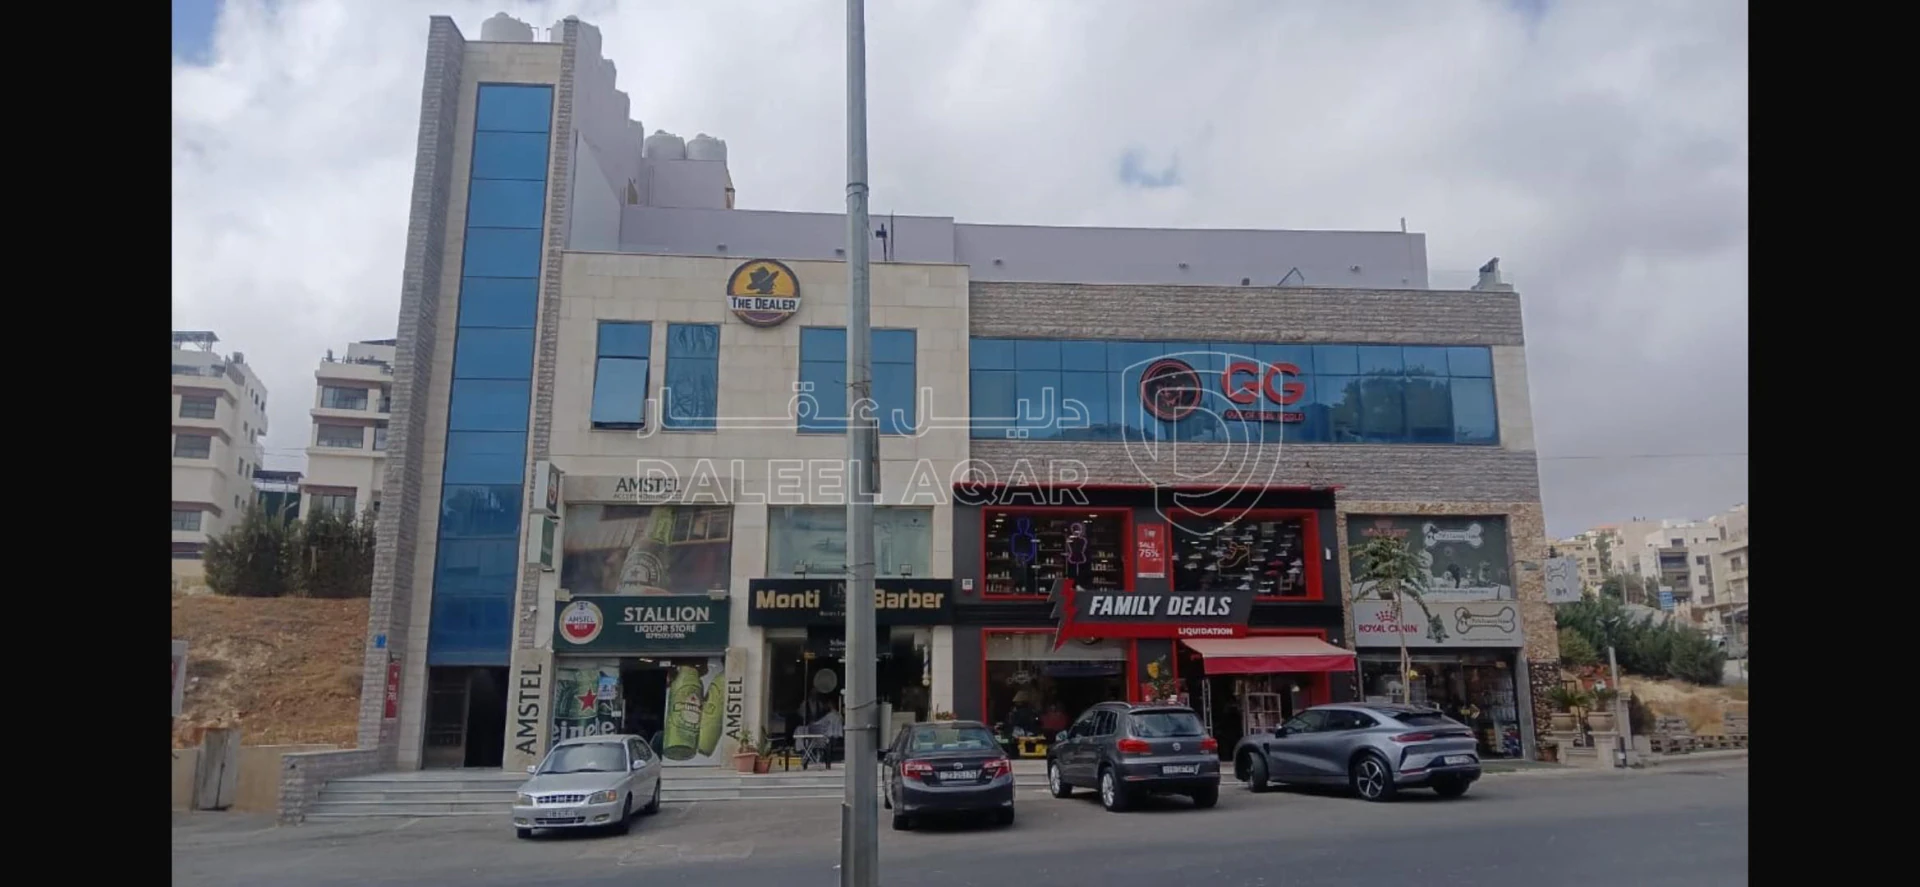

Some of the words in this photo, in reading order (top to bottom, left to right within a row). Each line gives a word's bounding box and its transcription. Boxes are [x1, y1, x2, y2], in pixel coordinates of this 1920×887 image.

[732, 297, 751, 309] THE
[755, 297, 795, 310] DEALER
[1221, 361, 1306, 405] GG
[615, 477, 681, 493] AMSTEL
[756, 588, 820, 609] Monti
[875, 588, 944, 609] Barber
[1089, 596, 1162, 616] FAMILY
[1167, 596, 1232, 616] DEALS
[624, 606, 710, 622] STALLION
[635, 624, 668, 634] LIQUOR
[671, 624, 696, 633] STORE
[1178, 627, 1233, 636] LIQUIDATION
[1359, 623, 1386, 633] ROYAL
[515, 664, 543, 756] AMSTEL
[726, 677, 743, 741] AMSTEL
